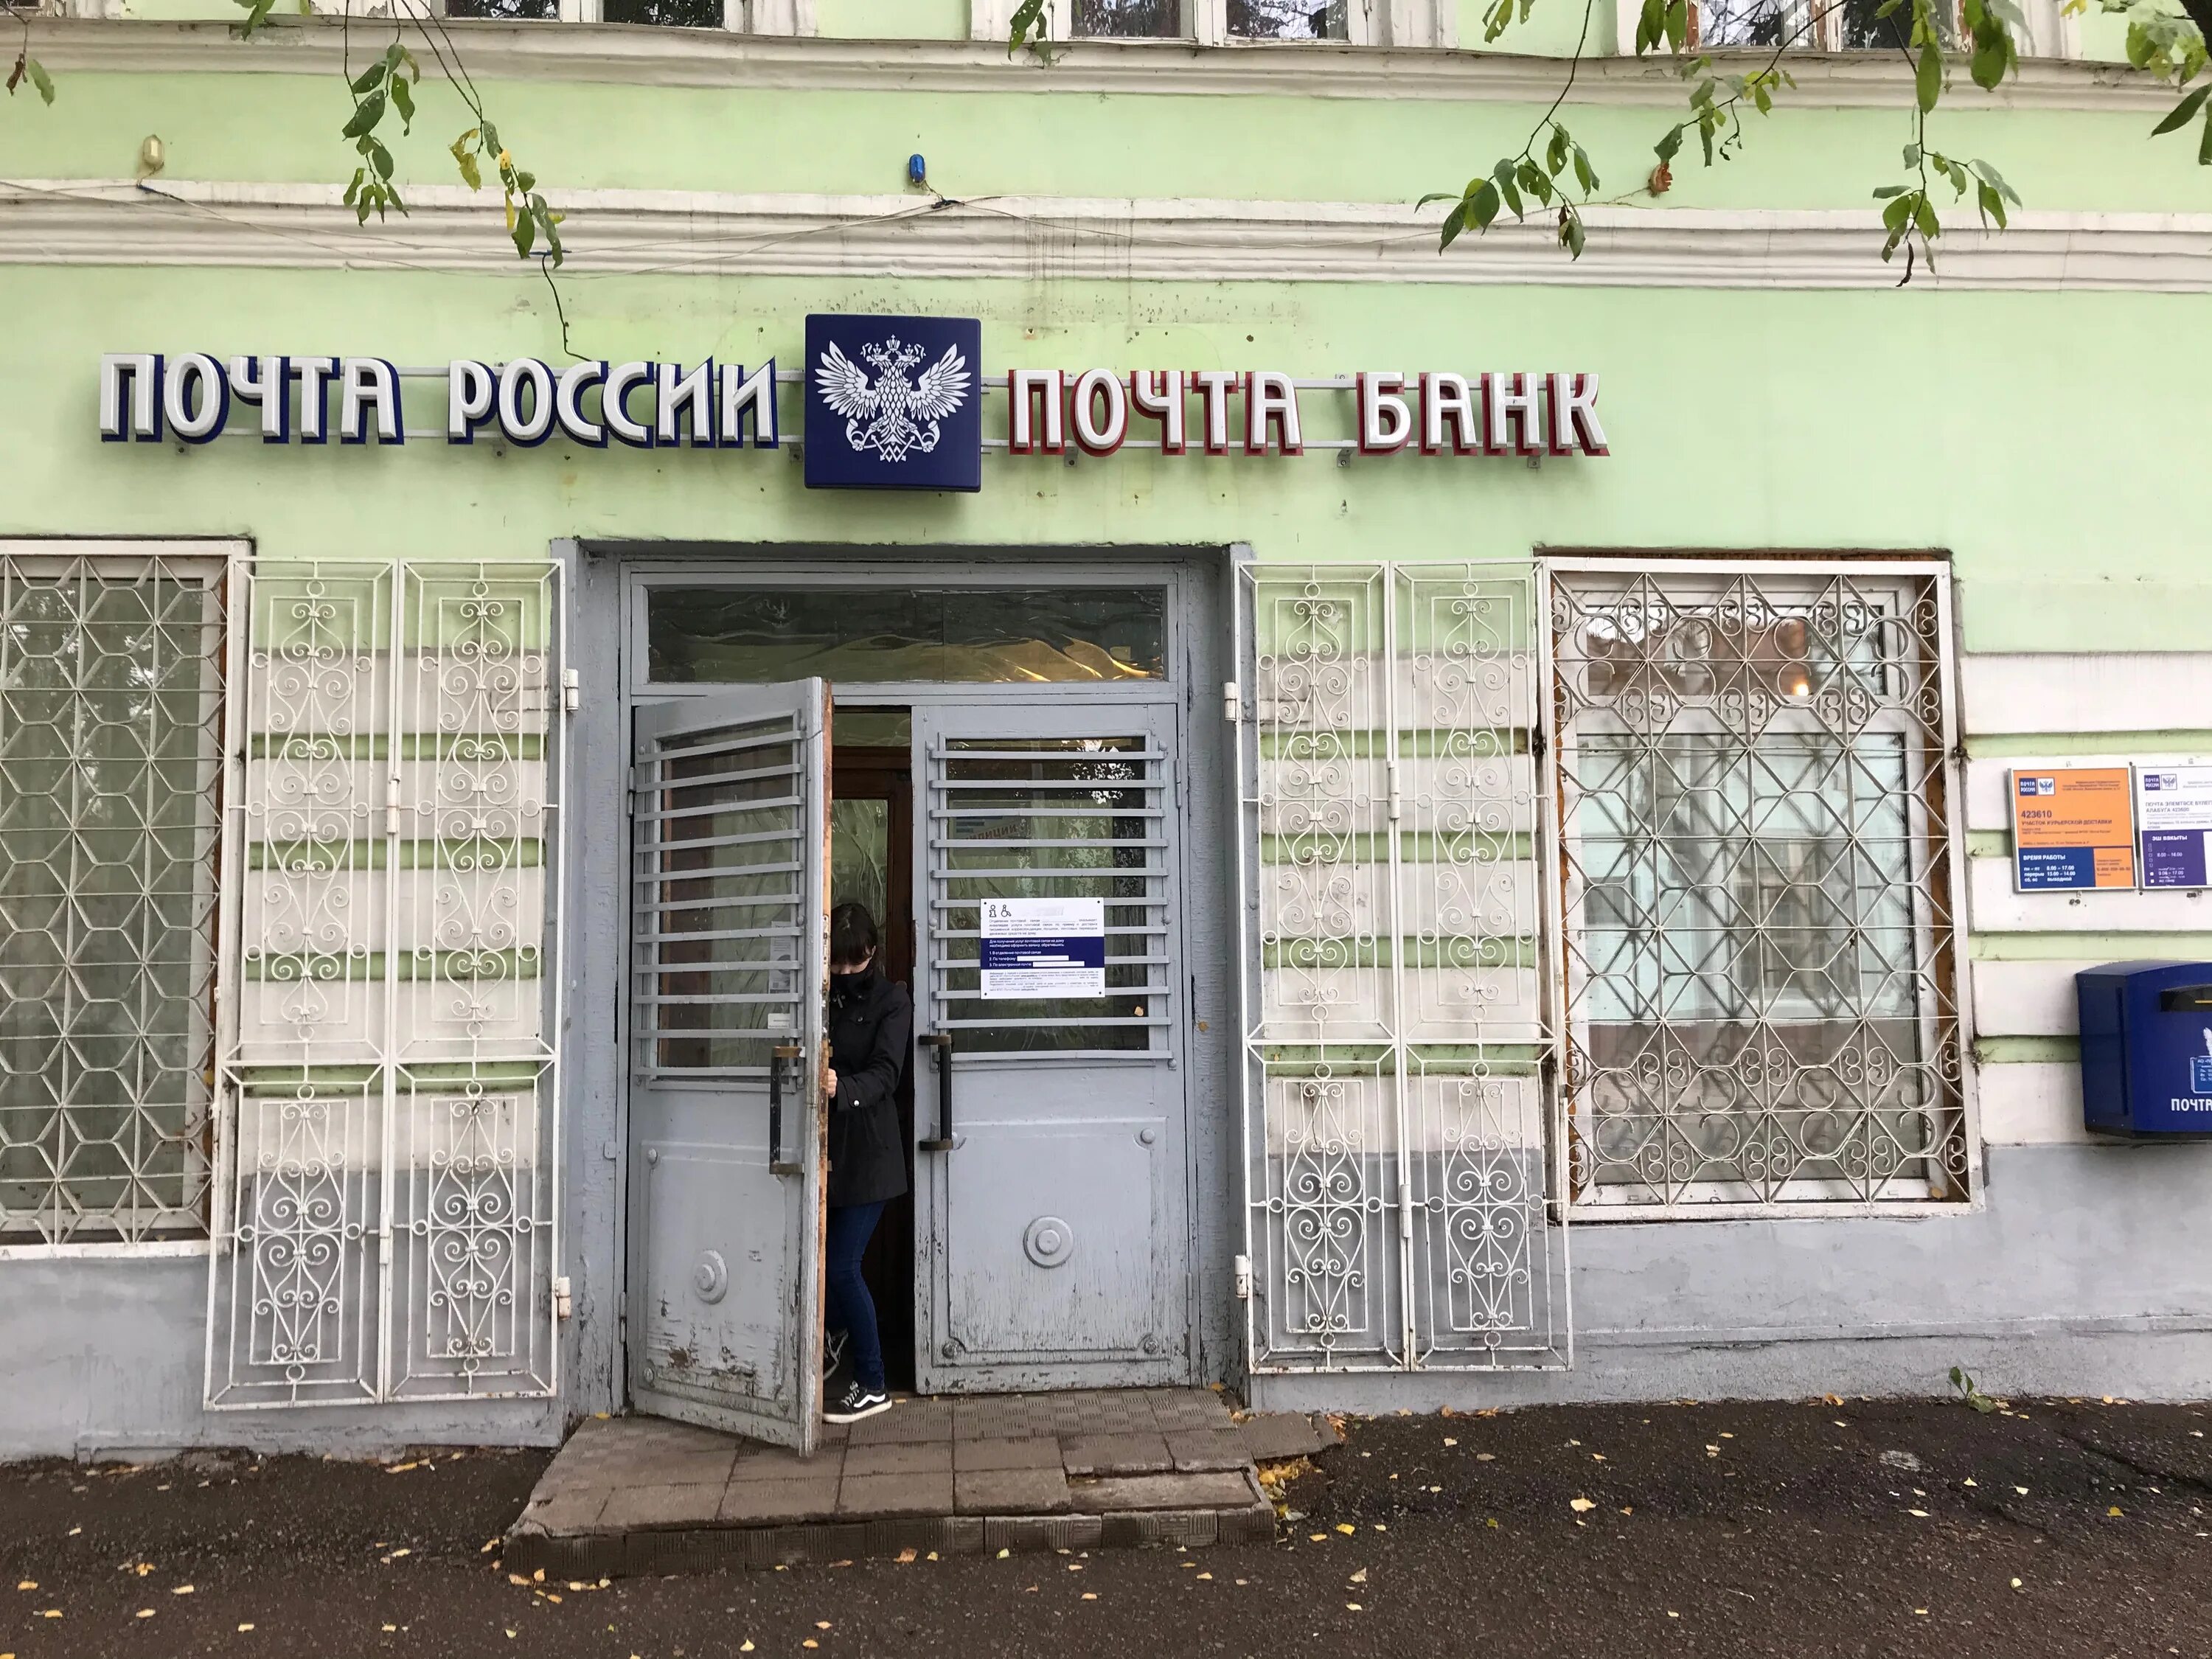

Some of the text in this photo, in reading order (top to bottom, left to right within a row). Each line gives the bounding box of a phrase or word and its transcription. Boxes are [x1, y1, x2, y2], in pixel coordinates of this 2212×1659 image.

[100, 352, 779, 448] ПОЧТА РОССИИ
[1008, 368, 1610, 456] ПОЧТА БАНК
[2021, 810, 2052, 818] 423610
